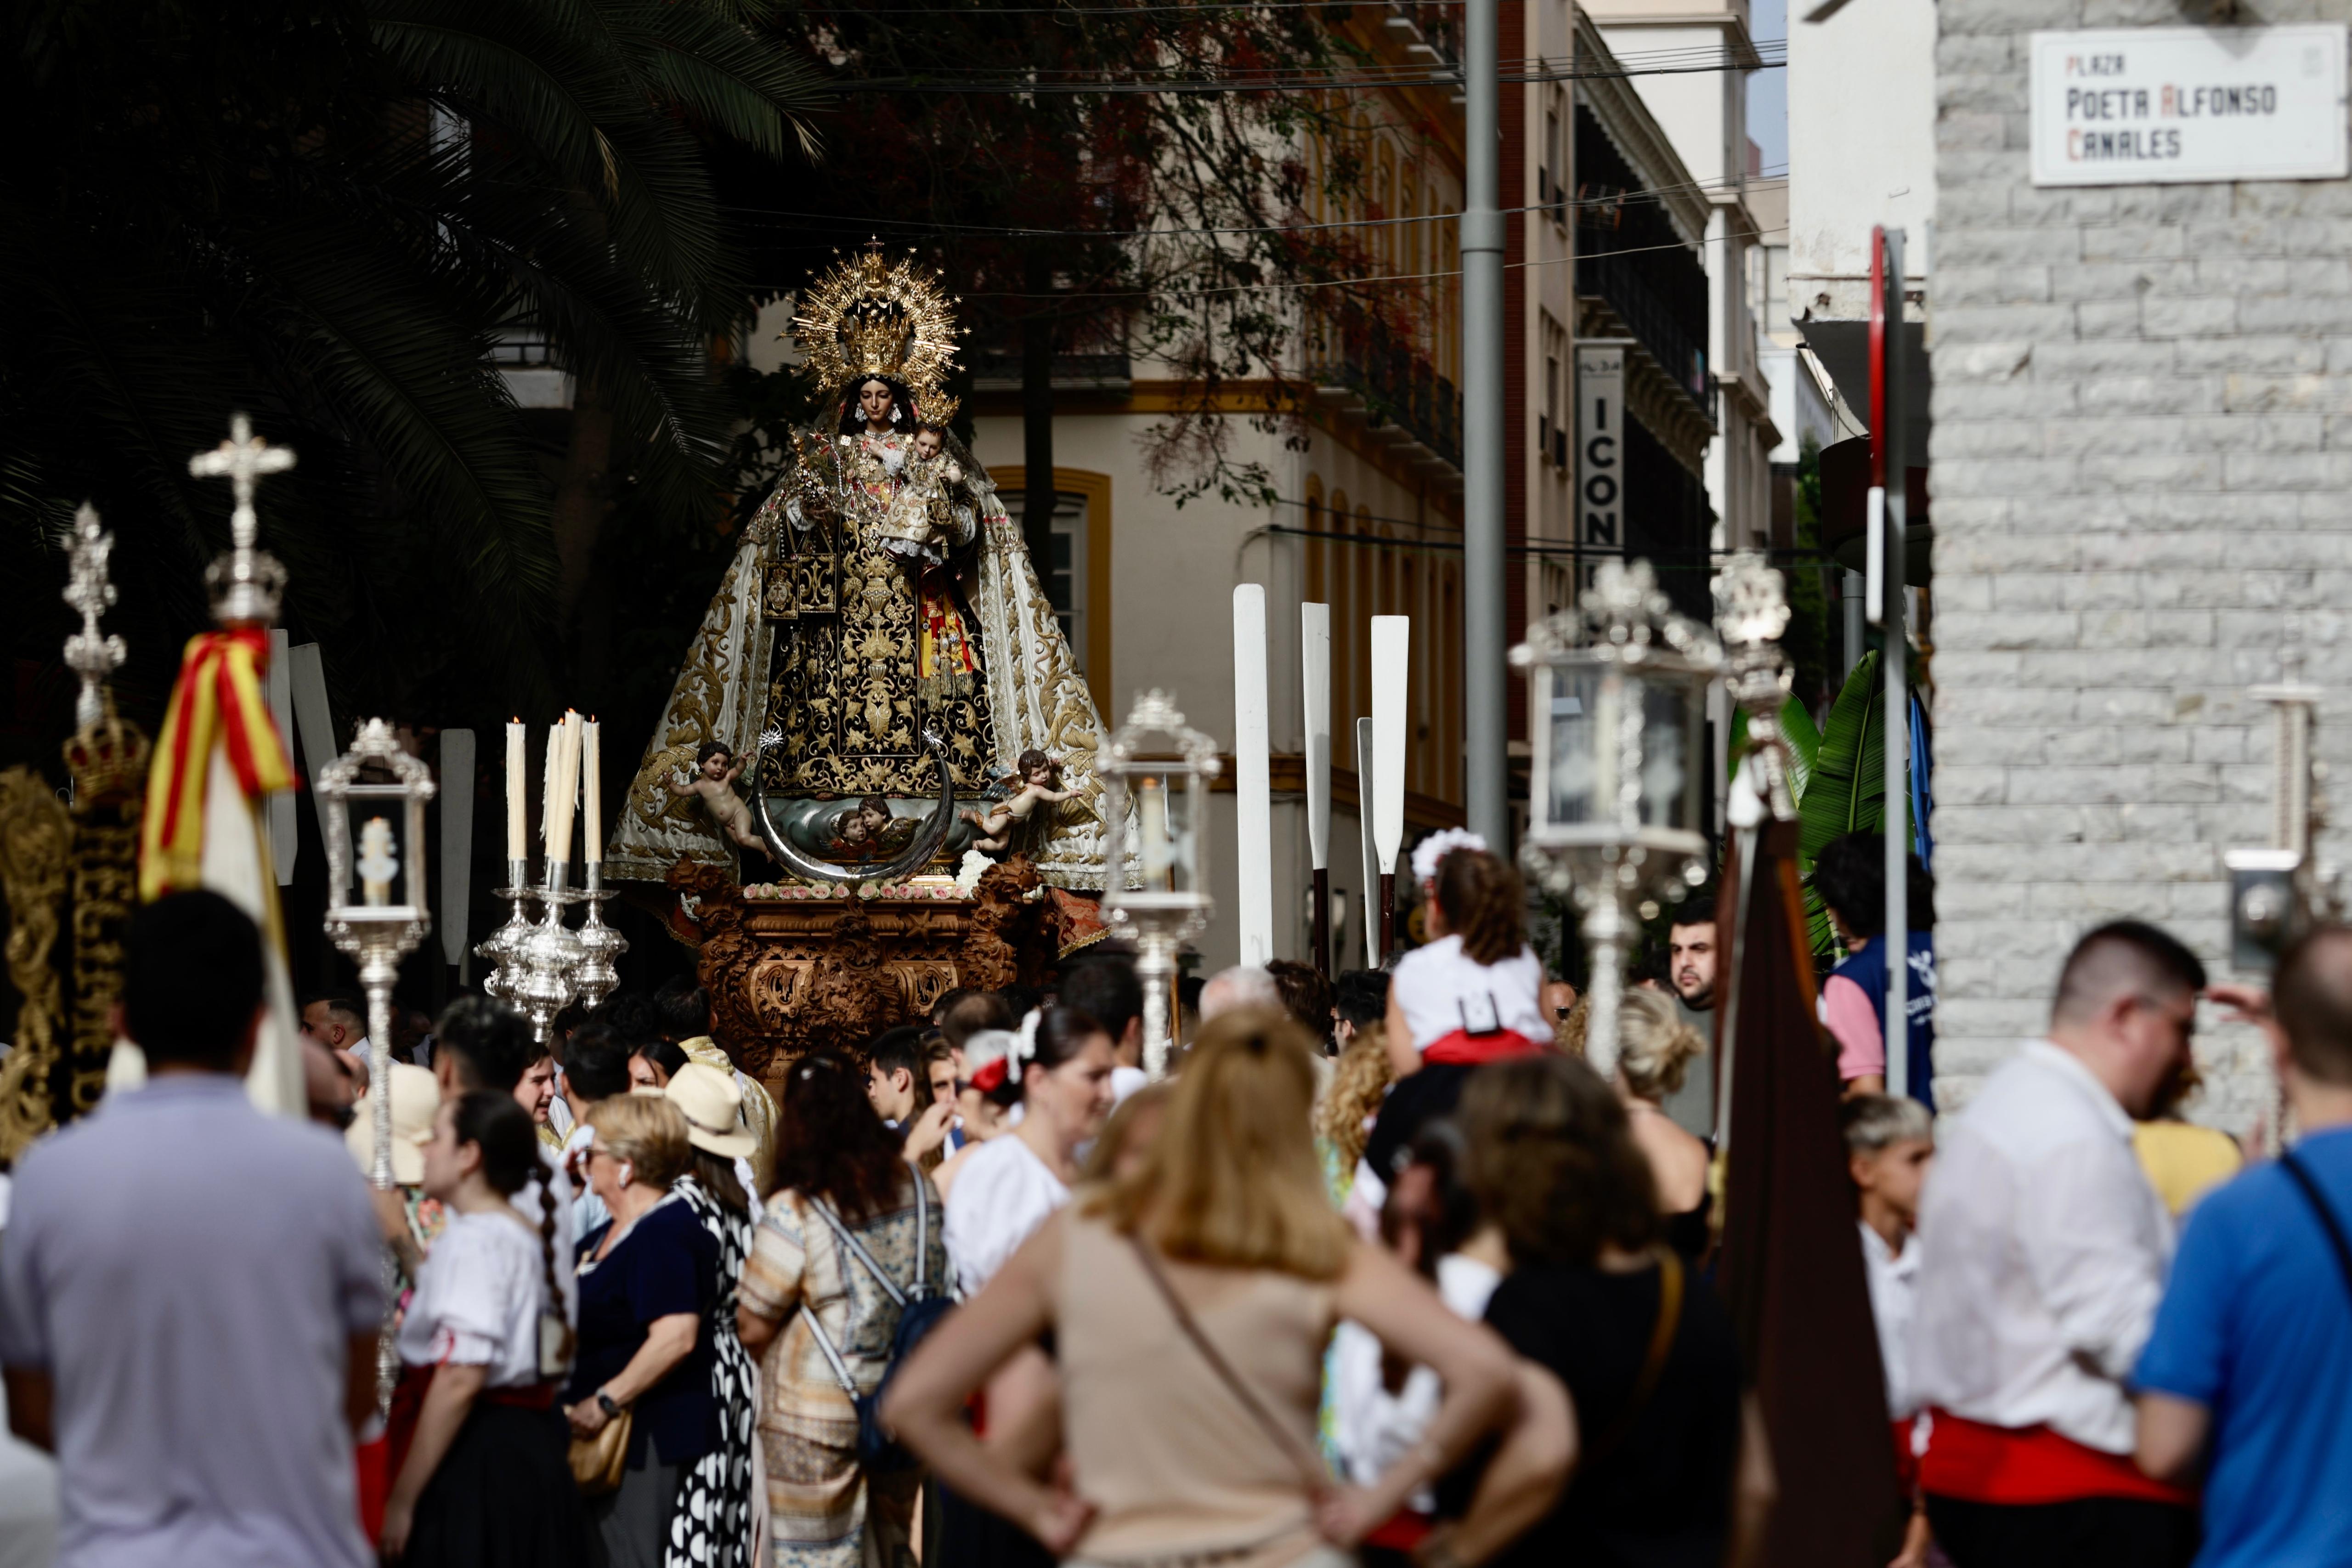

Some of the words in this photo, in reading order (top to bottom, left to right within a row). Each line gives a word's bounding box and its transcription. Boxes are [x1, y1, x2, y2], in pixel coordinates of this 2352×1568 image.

[2067, 56, 2125, 76] PLAZA
[2067, 88, 2149, 120] POETA
[2160, 85, 2277, 118] ALFONSO
[2067, 128, 2181, 161] CANALES
[1585, 398, 1617, 545] ICON
